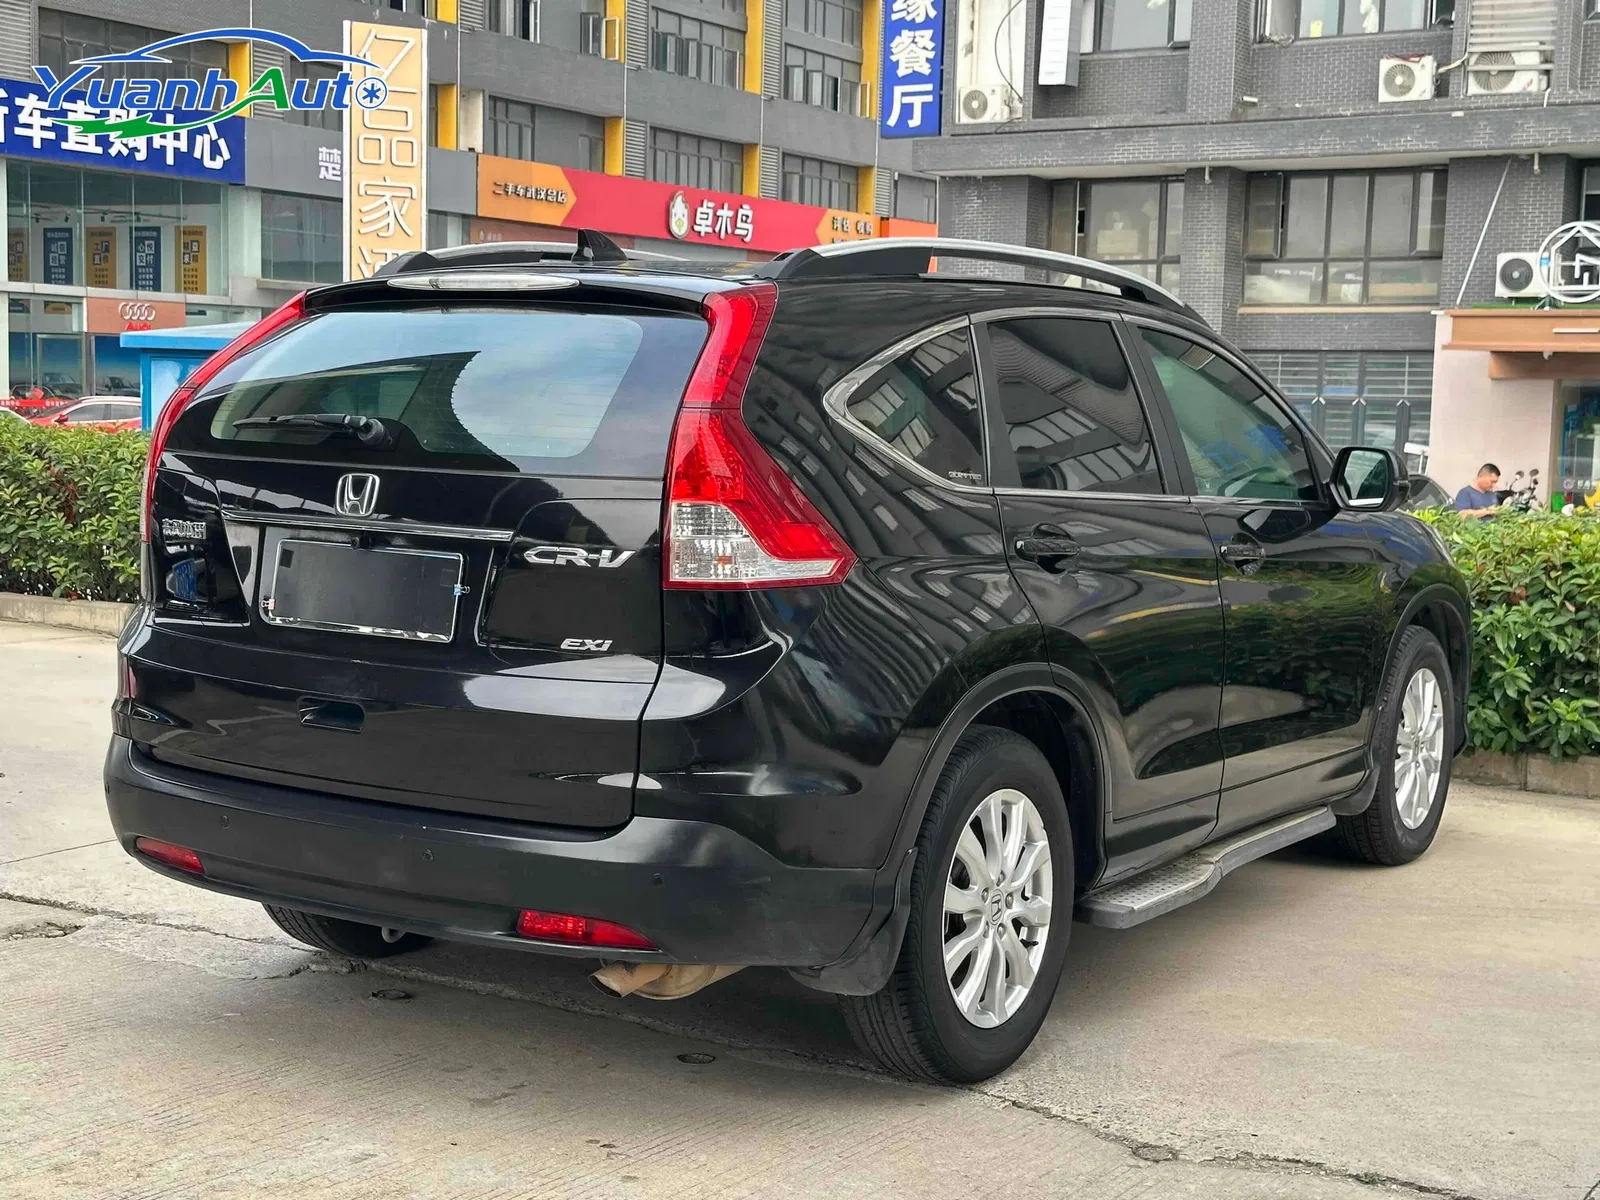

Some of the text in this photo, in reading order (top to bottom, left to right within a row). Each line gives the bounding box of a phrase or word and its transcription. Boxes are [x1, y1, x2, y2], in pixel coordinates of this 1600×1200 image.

[0, 89, 231, 170] 车直购中心
[693, 199, 754, 242] 卓木鸟
[523, 545, 636, 569] CR-V
